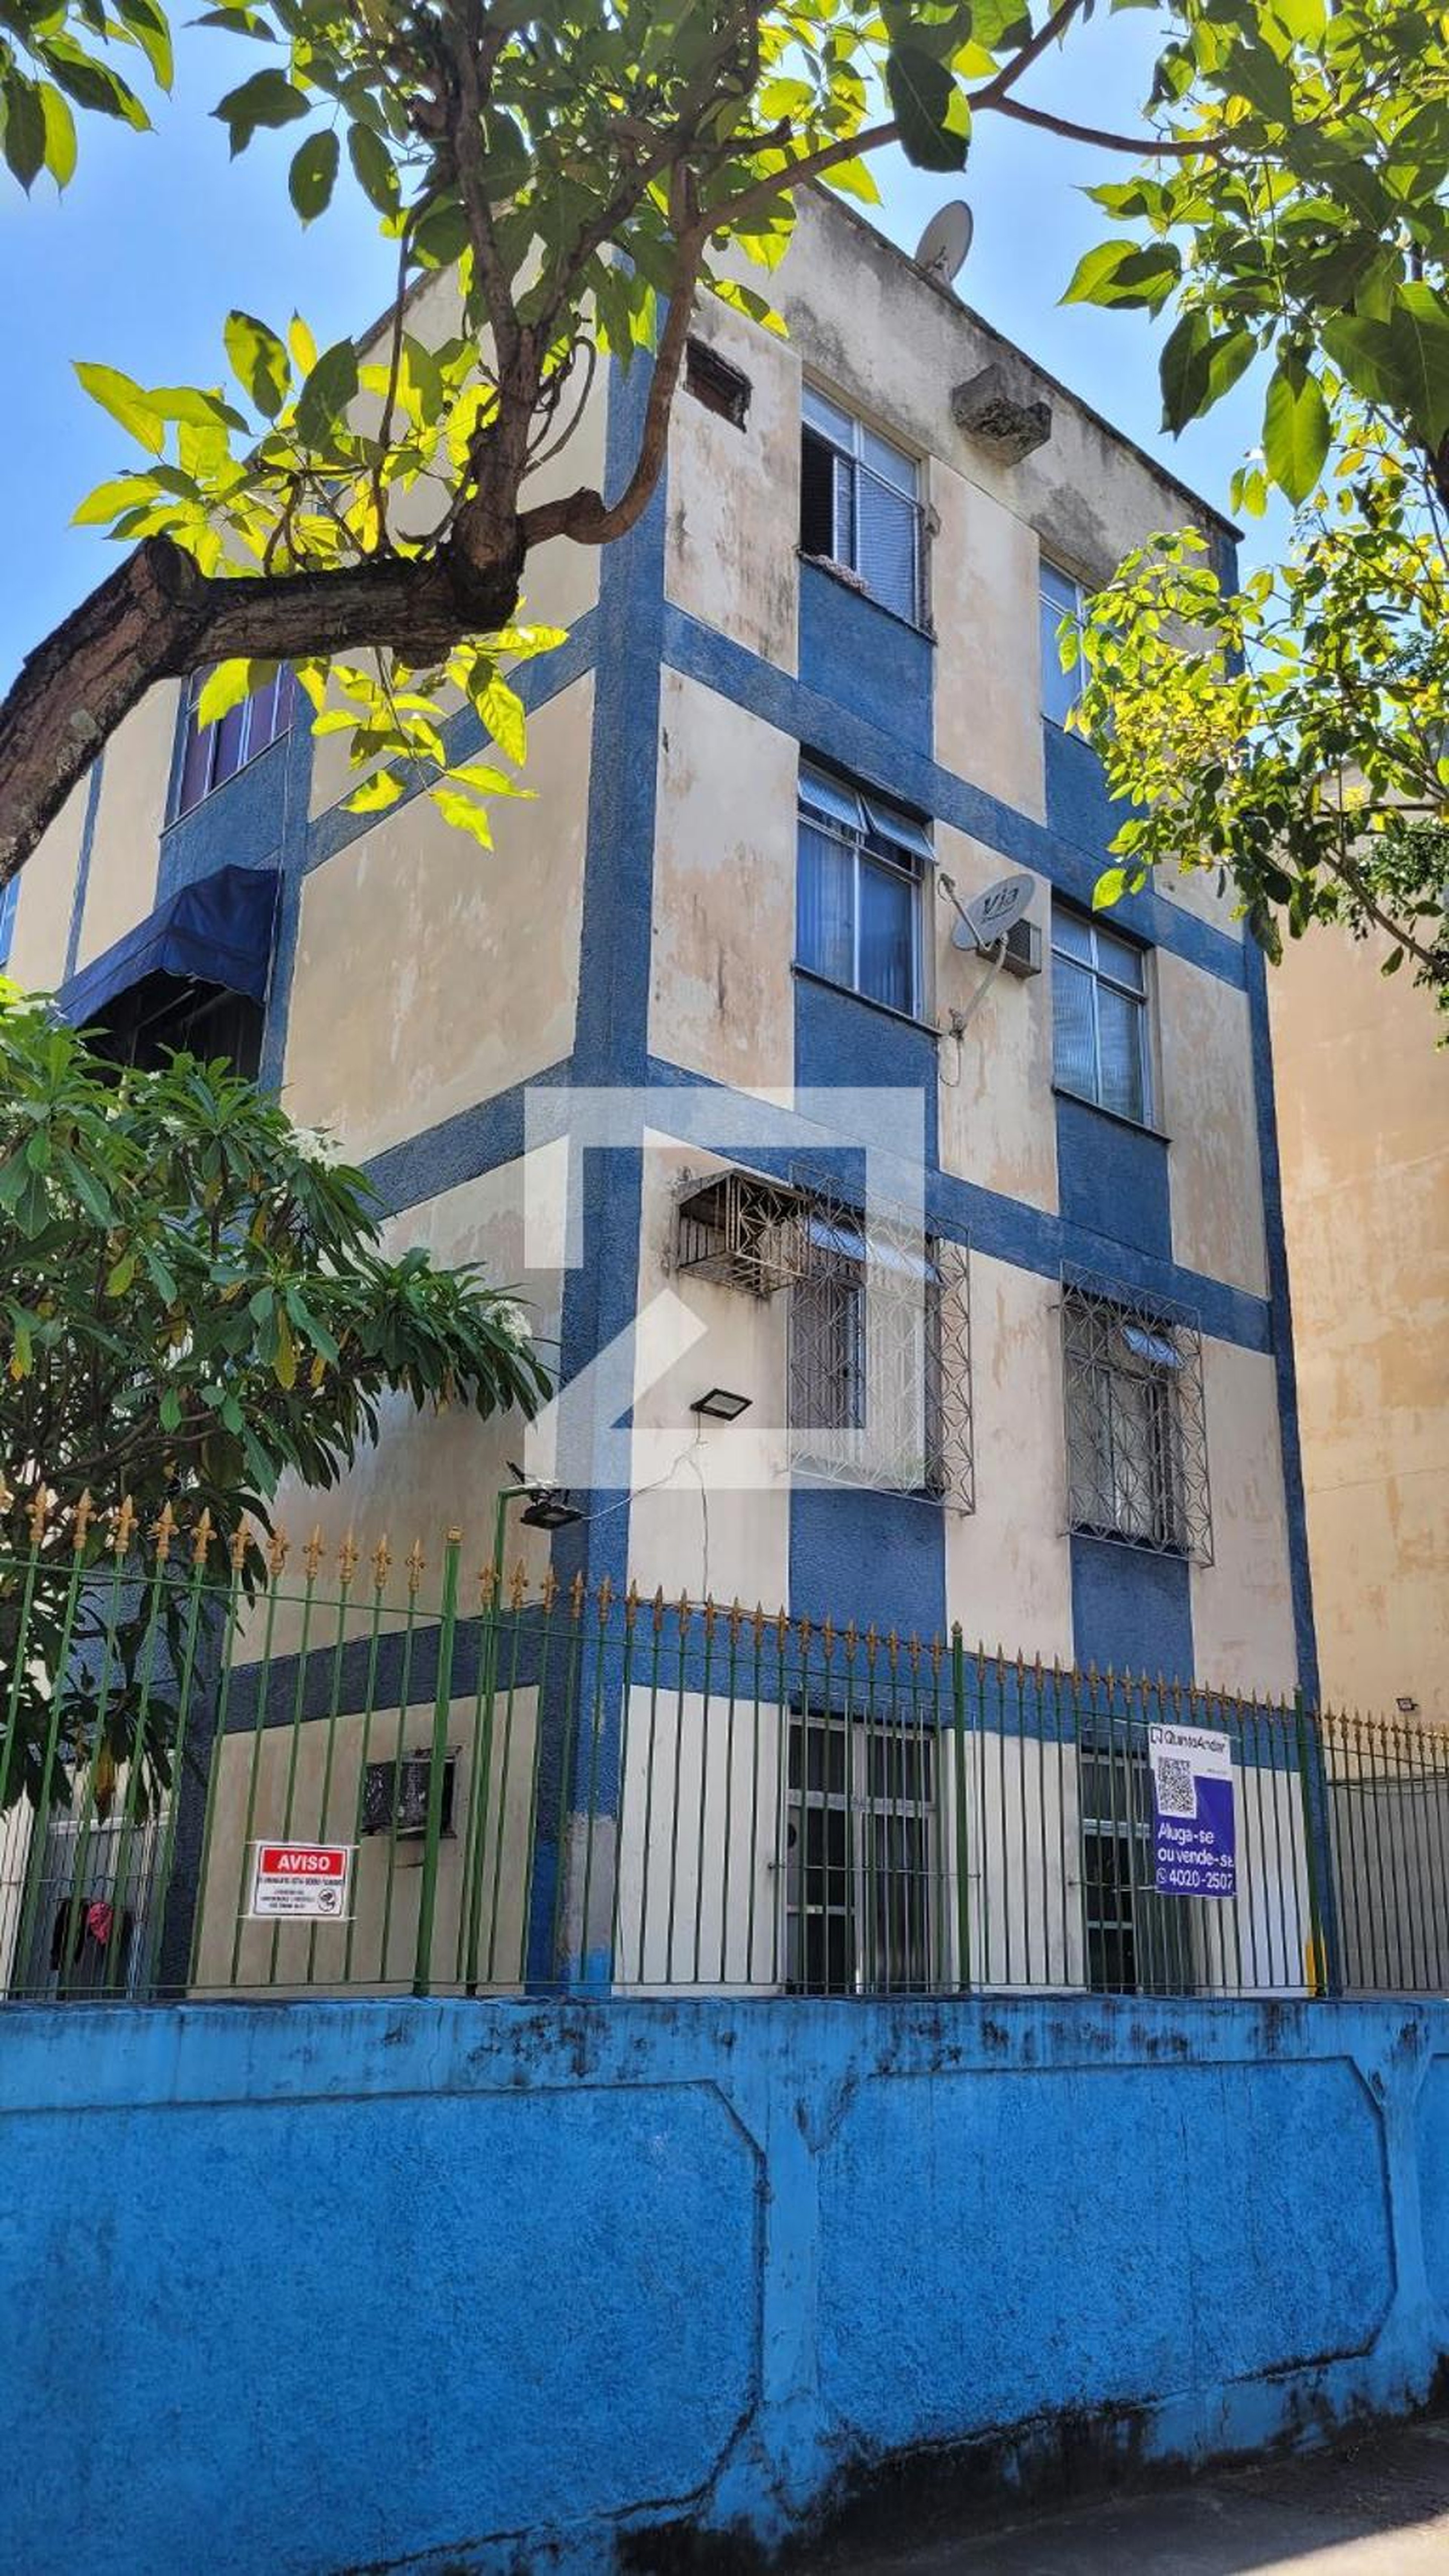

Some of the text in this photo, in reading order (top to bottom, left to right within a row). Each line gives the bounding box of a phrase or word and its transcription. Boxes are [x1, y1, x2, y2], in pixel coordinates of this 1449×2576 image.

[1158, 1822, 1214, 1846] Aluga-se
[278, 1854, 330, 1870] AVISO
[1158, 1848, 1174, 1861] ou
[1170, 1869, 1233, 1889] 4020-2507
